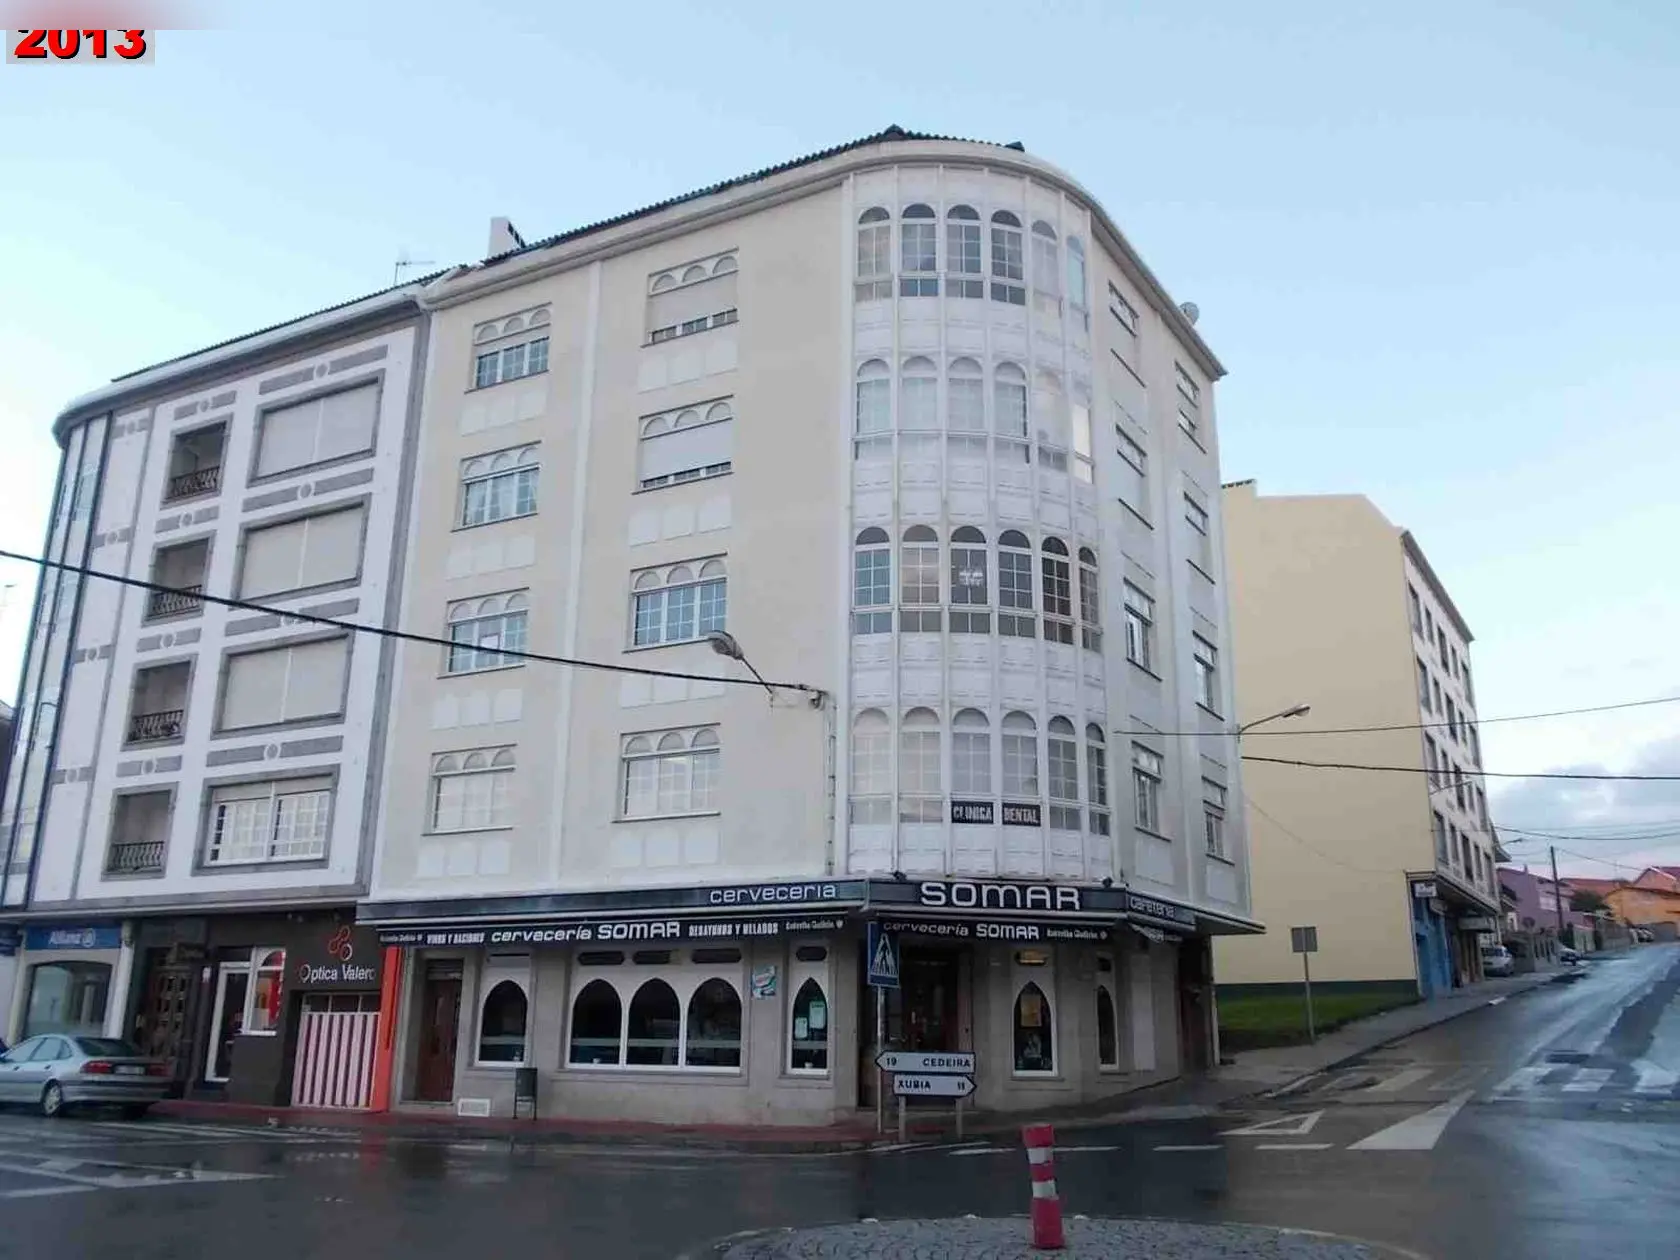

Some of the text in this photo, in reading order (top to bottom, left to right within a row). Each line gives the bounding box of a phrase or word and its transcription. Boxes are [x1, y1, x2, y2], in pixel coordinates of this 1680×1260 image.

[1003, 807, 1039, 823] DENTAL
[920, 882, 1081, 910] SOMAR
[597, 921, 681, 940] SOMAR
[734, 924, 742, 936] Y
[975, 923, 1040, 940] SOMAR
[342, 963, 377, 981] Valero
[886, 1057, 971, 1068] 19 CEDEIRA
[898, 1080, 932, 1090] XUBIA
